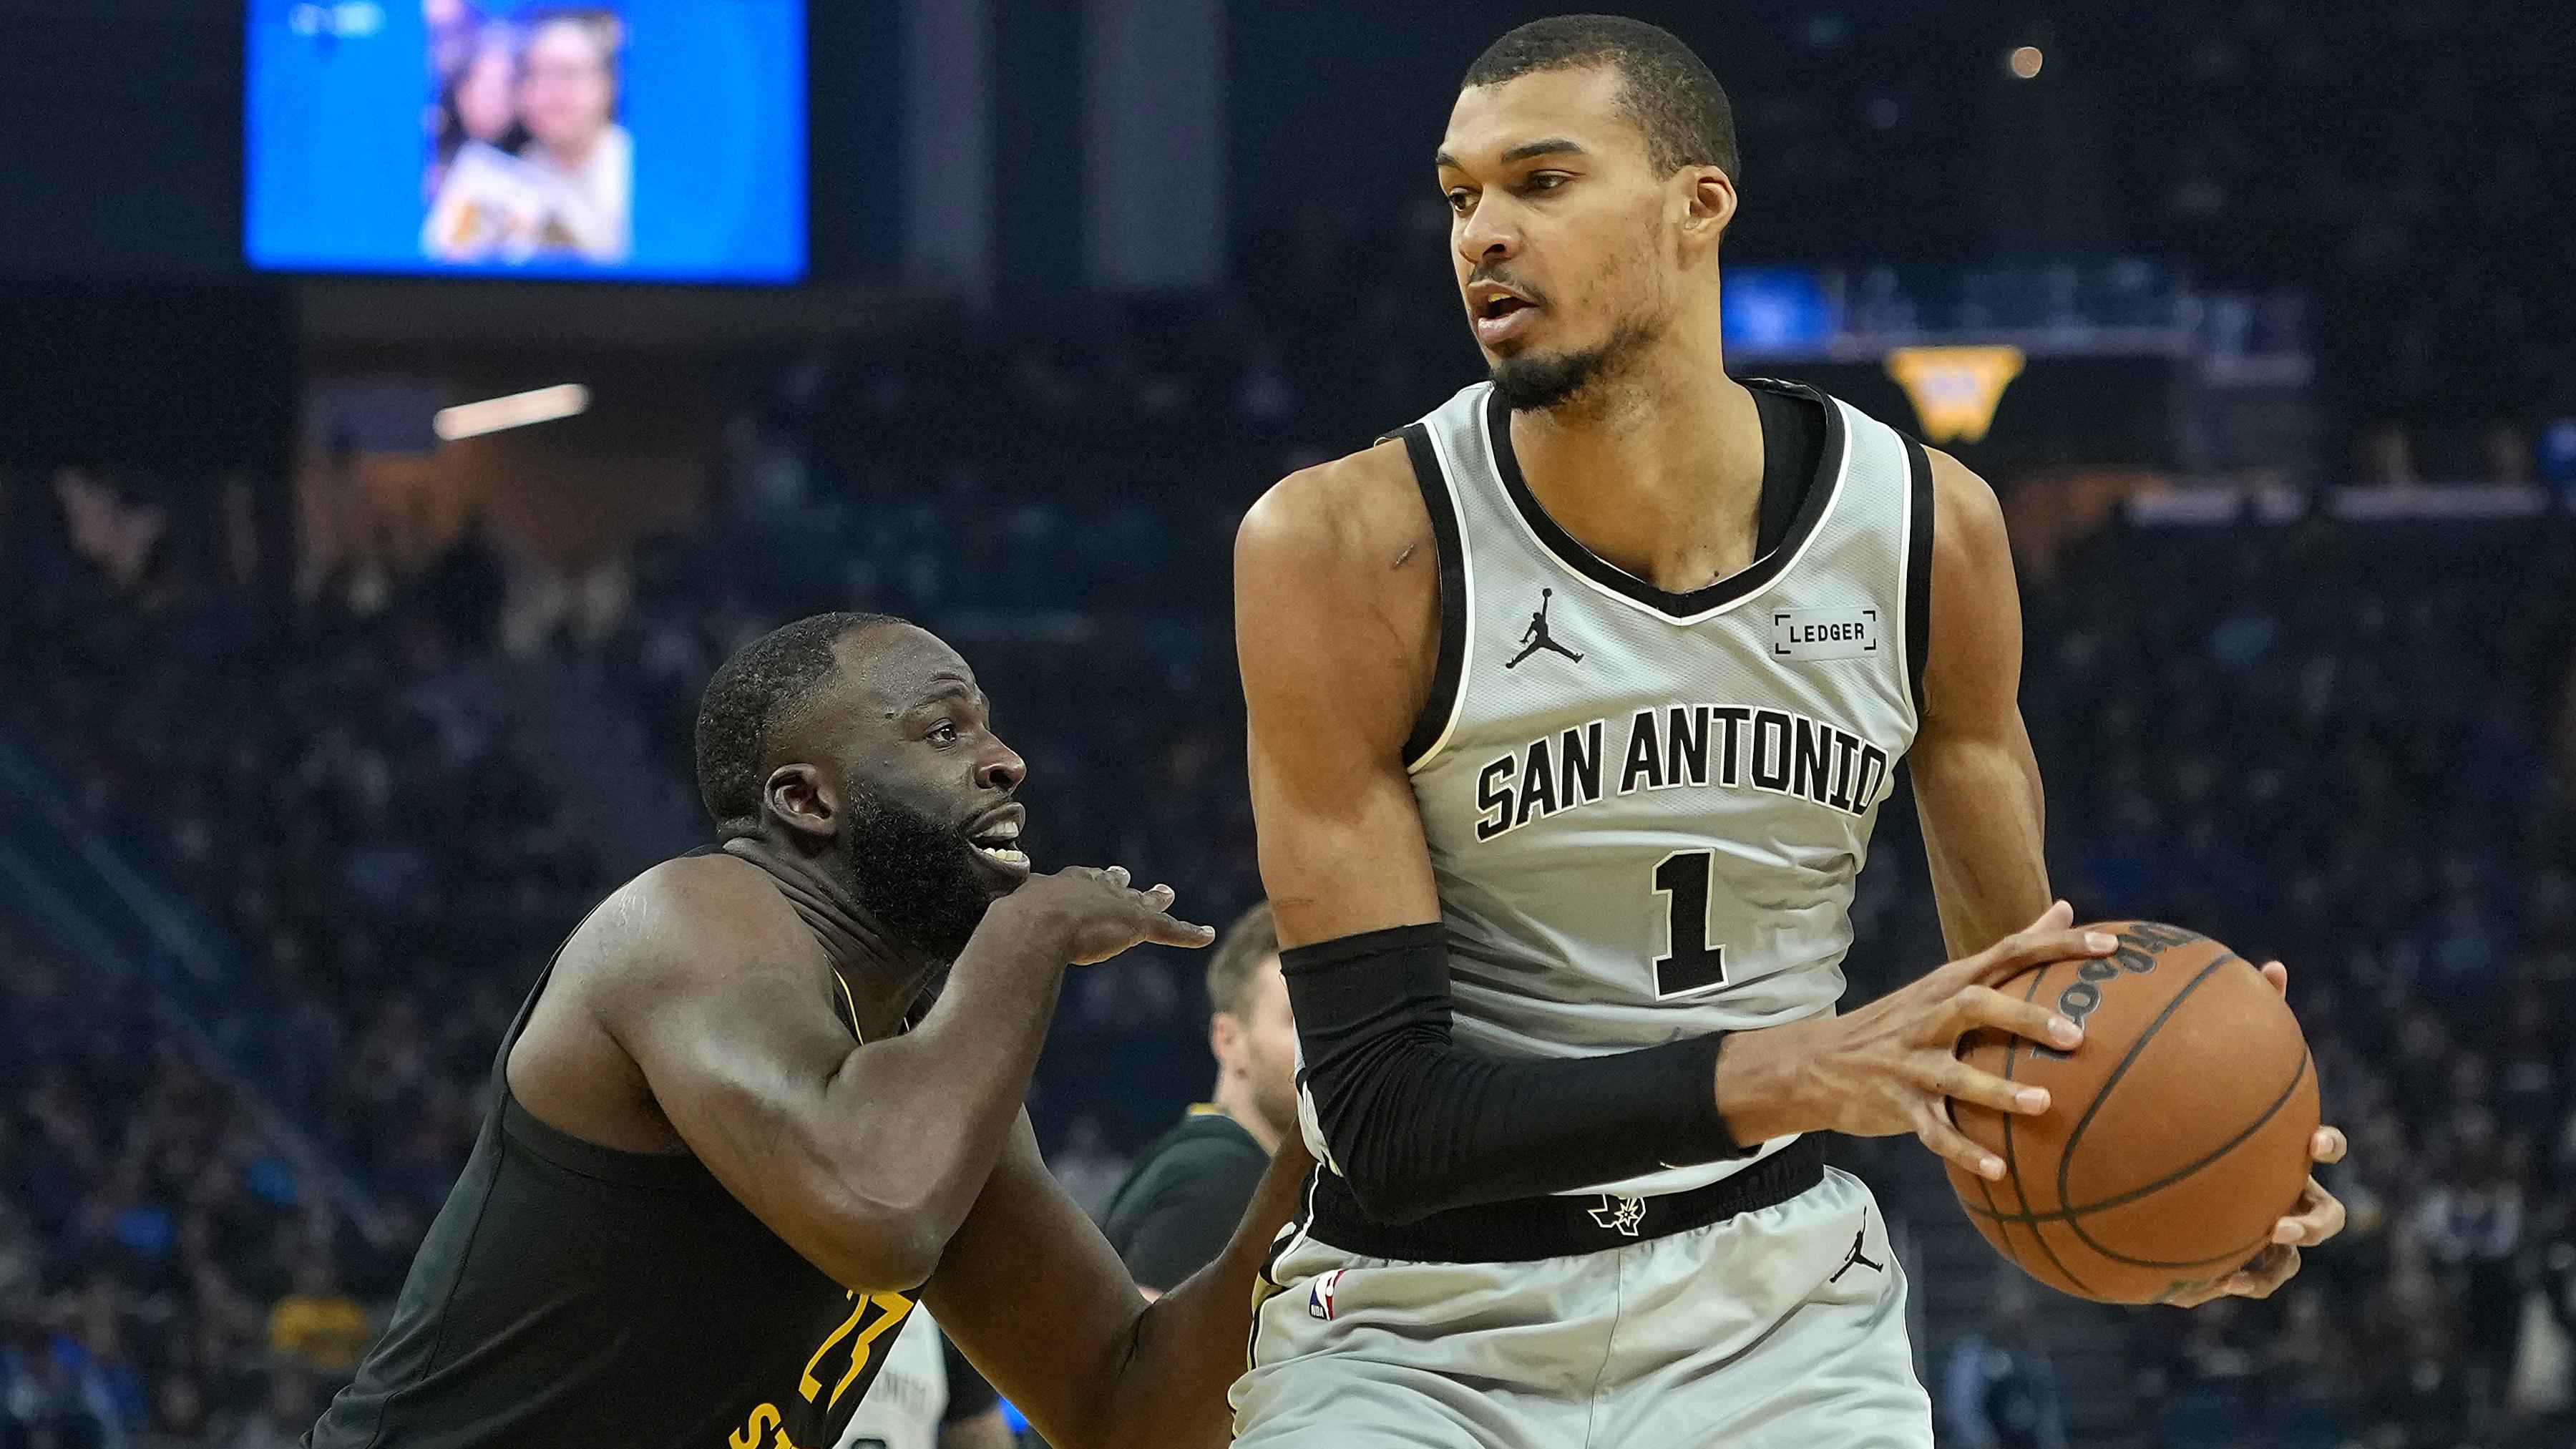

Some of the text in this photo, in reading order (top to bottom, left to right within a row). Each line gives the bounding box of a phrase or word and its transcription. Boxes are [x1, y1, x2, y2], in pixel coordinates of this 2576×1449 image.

[1790, 623, 1865, 643] LEDGER
[1475, 703, 1889, 844] SAN ANTONIO
[1652, 848, 1729, 1000] 1
[1311, 1304, 1324, 1317] NBA
